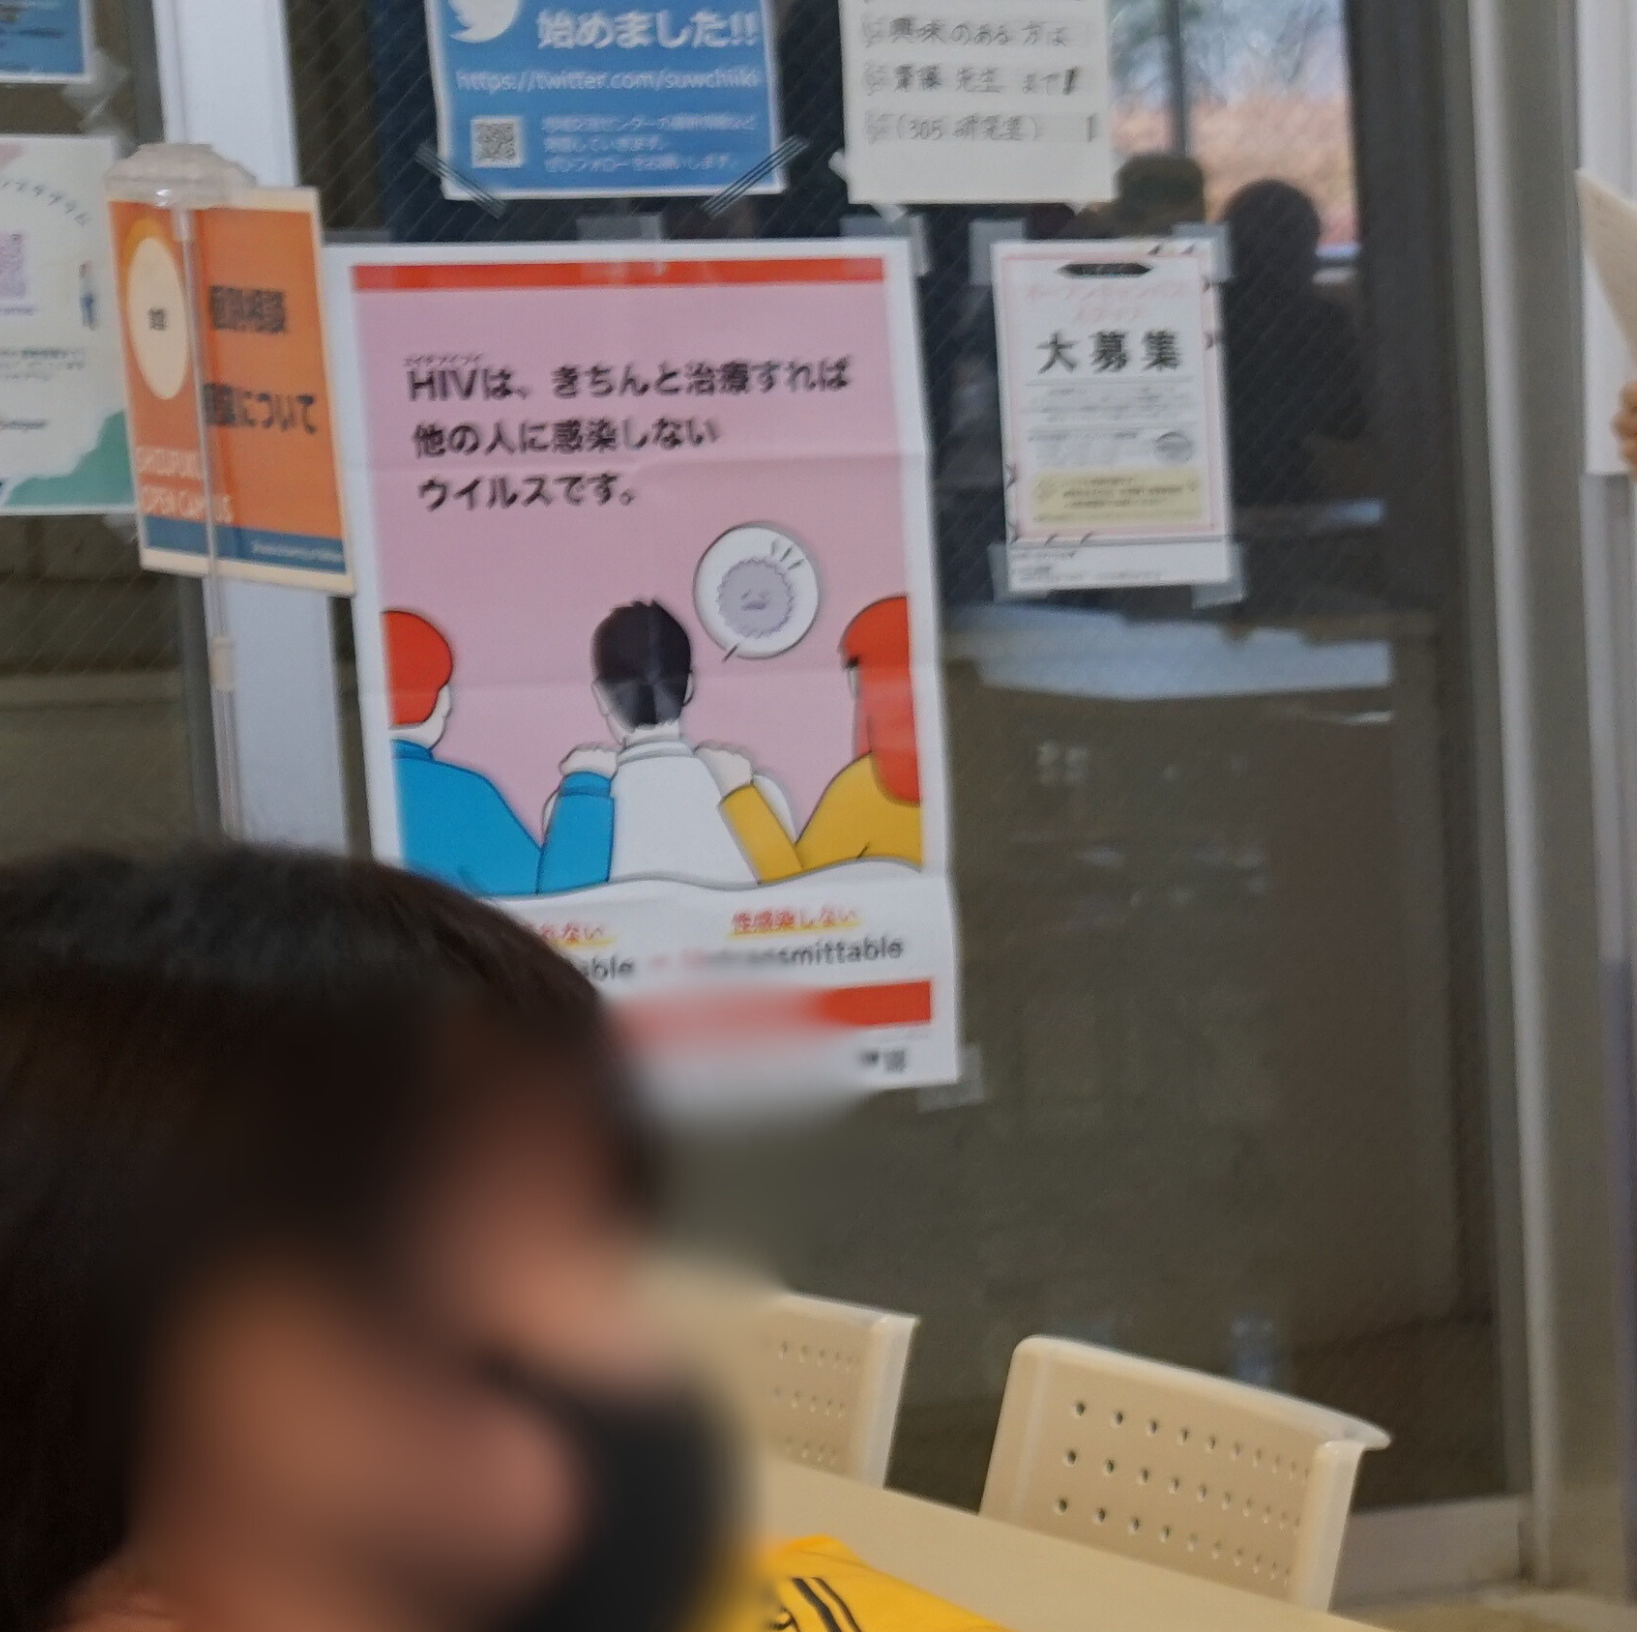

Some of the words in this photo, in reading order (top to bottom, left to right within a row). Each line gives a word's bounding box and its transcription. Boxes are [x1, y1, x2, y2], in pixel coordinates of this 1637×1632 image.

[1036, 328, 1183, 375] 大募集
[411, 417, 721, 459] 他の人に感染しない
[417, 471, 637, 513] ウイルスです。
